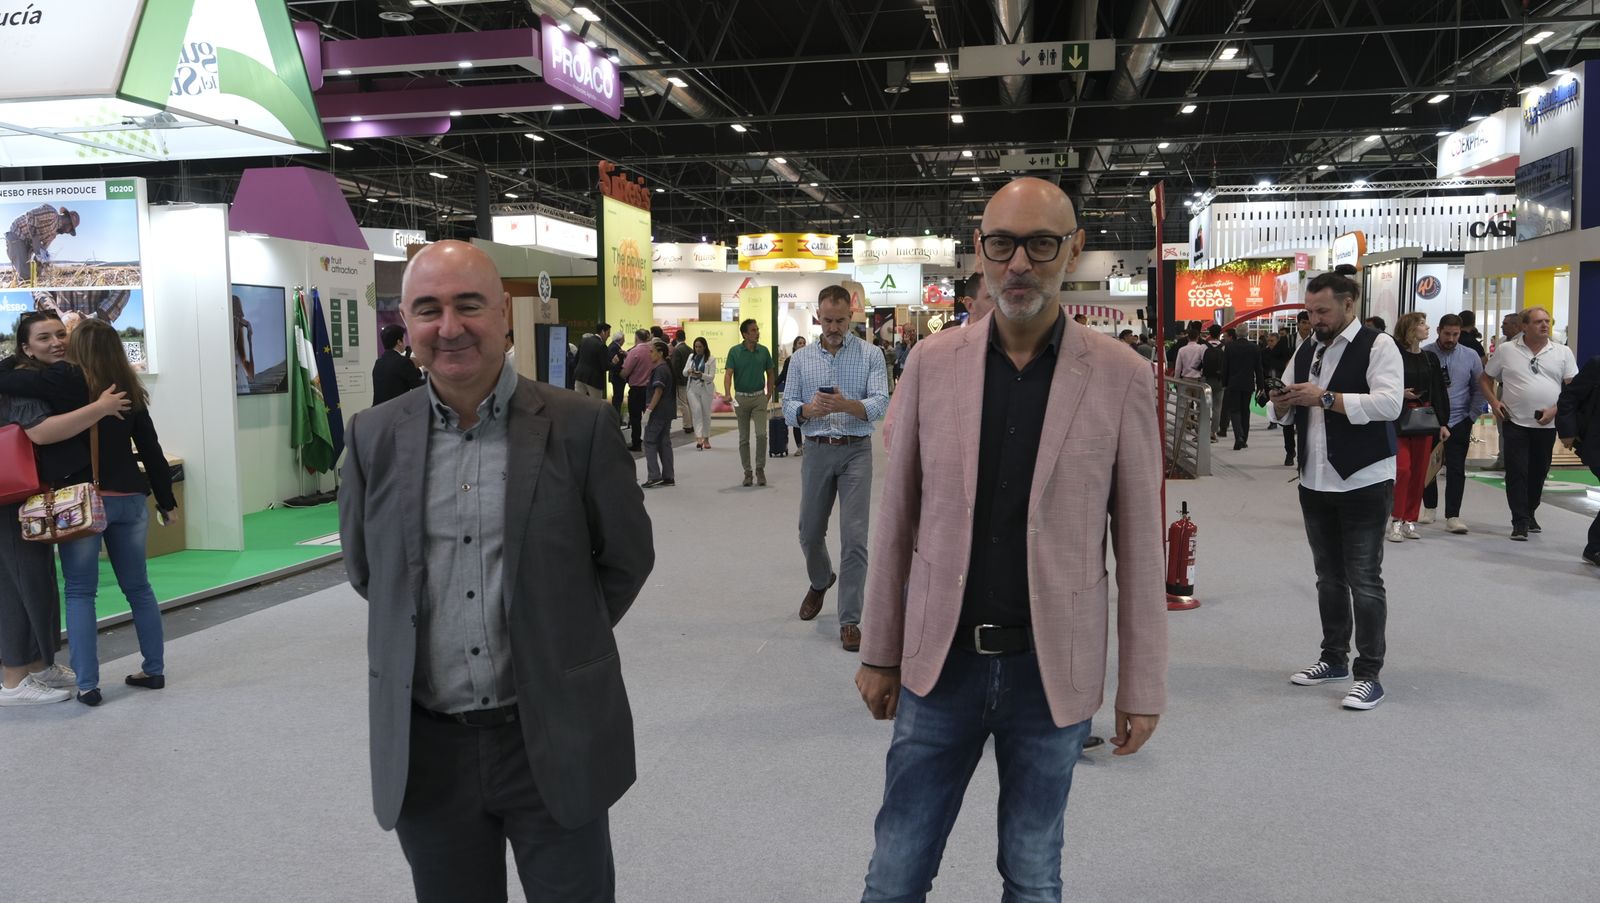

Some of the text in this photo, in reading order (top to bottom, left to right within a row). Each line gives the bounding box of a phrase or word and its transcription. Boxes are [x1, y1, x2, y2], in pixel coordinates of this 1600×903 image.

[552, 47, 613, 99] PROACO
[27, 187, 54, 196] FRESH
[56, 186, 97, 195] PRODUCE
[109, 185, 134, 193] 9D20D
[331, 256, 342, 265] fruit
[612, 246, 625, 265] The
[331, 266, 358, 275] attraction
[613, 270, 620, 287] of
[1187, 289, 1223, 298] COSA
[1188, 298, 1233, 307] TODOS
